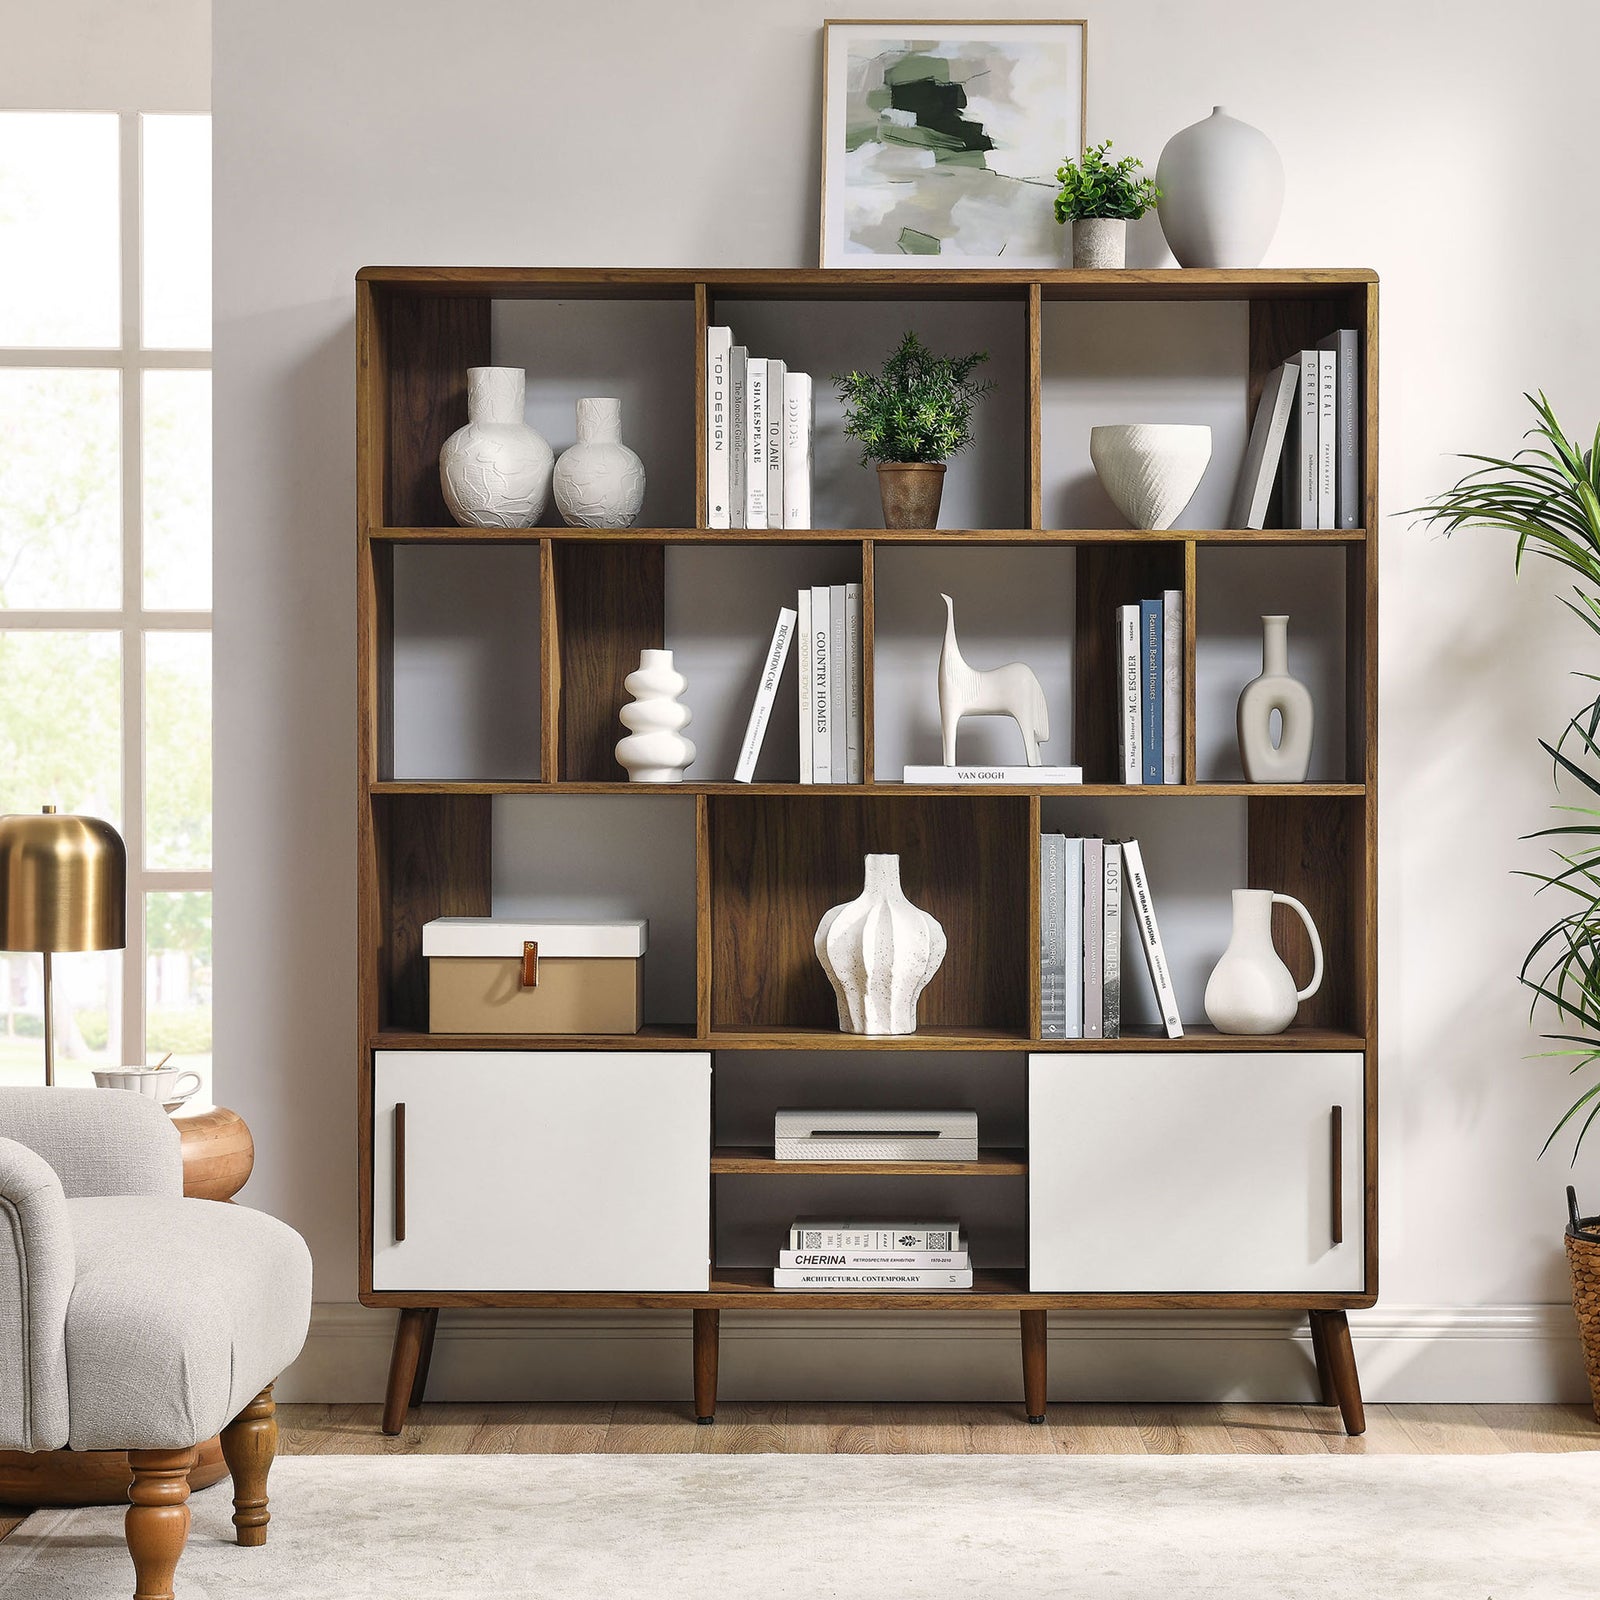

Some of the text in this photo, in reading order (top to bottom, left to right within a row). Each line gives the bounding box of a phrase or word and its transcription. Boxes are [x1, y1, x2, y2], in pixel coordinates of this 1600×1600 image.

[714, 354, 723, 451] TOP DESIGN
[1306, 363, 1315, 416] CEREAL
[1324, 365, 1332, 417] CEREAL
[735, 429, 743, 452] Guide
[754, 381, 762, 463] SHAKESPEARE
[769, 421, 780, 471] TO JANE
[764, 624, 788, 692] DECORATION CASE
[816, 631, 827, 733] COUNTRY HOMES
[1128, 655, 1136, 691] ESCHER
[1105, 863, 1118, 977] LOST IN NATURE
[1135, 873, 1156, 945] NEW URBAN HOUSING
[795, 1255, 846, 1265] CHERINA
